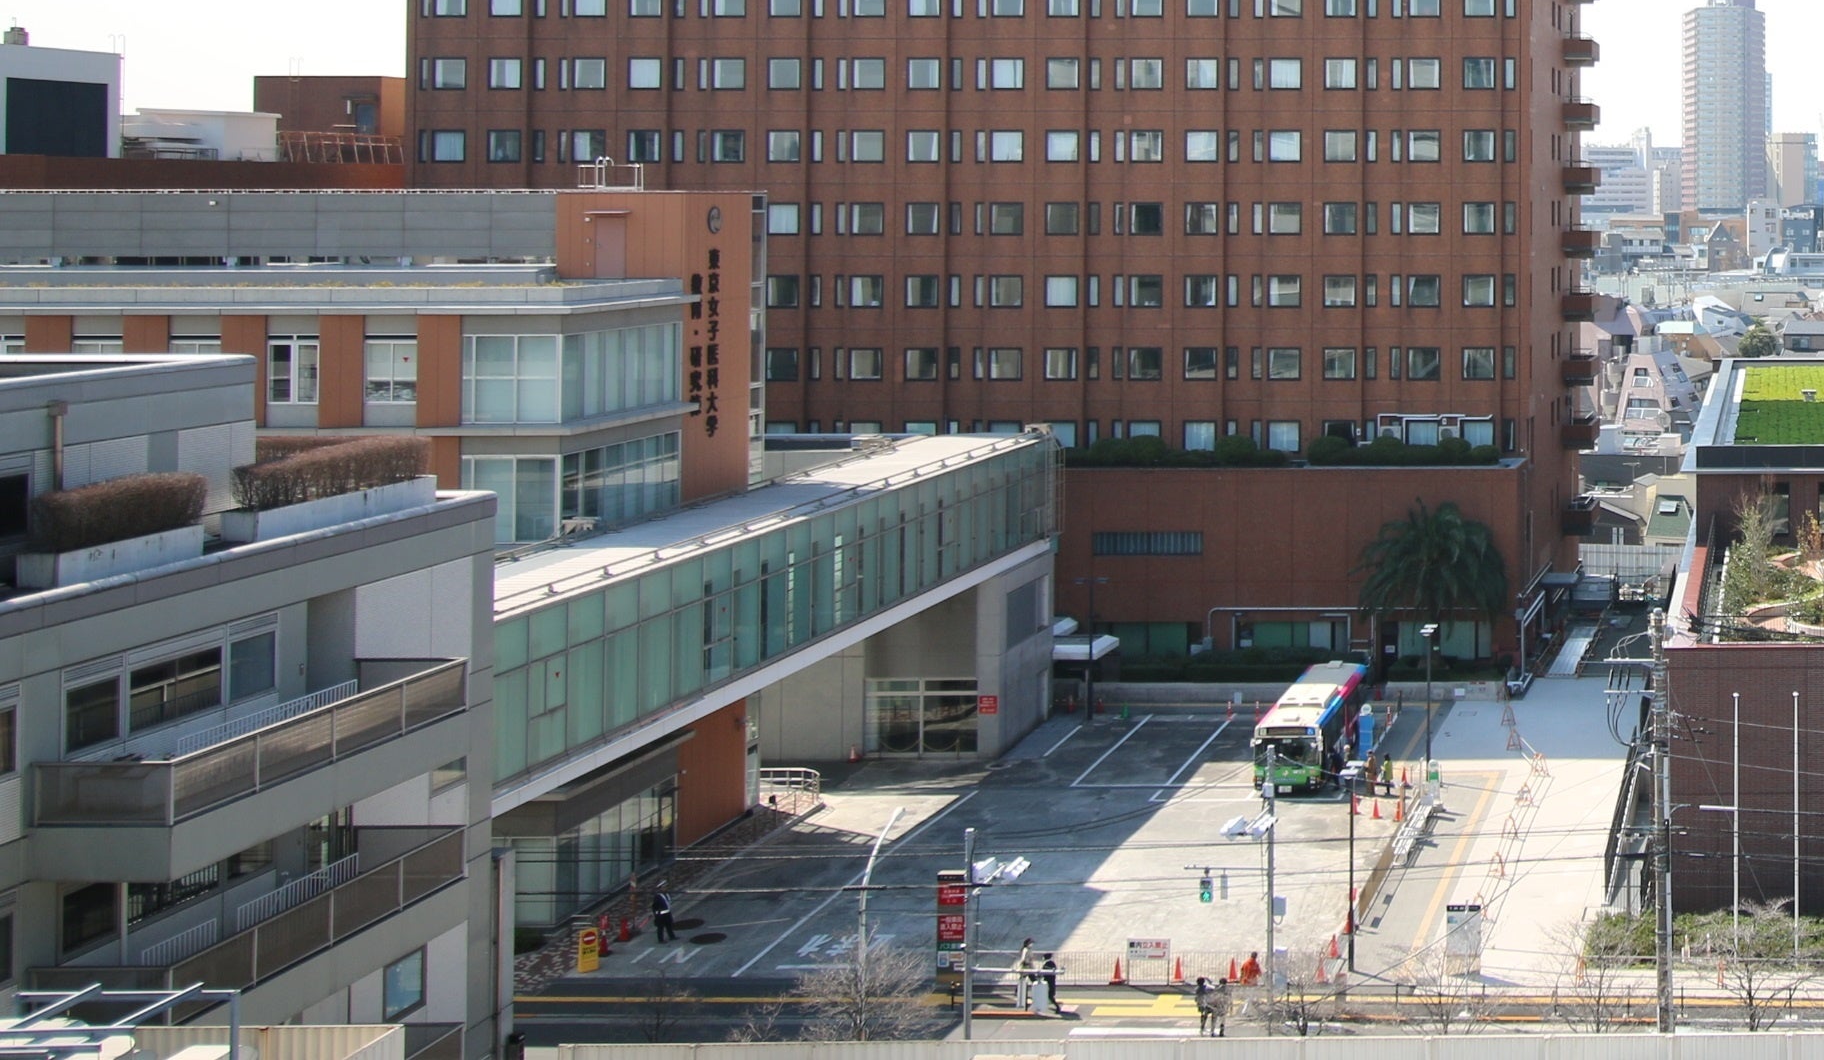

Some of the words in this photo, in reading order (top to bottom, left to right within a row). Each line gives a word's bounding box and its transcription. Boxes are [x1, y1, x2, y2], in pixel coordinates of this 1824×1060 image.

[706, 249, 720, 437] 東京女子医科大学
